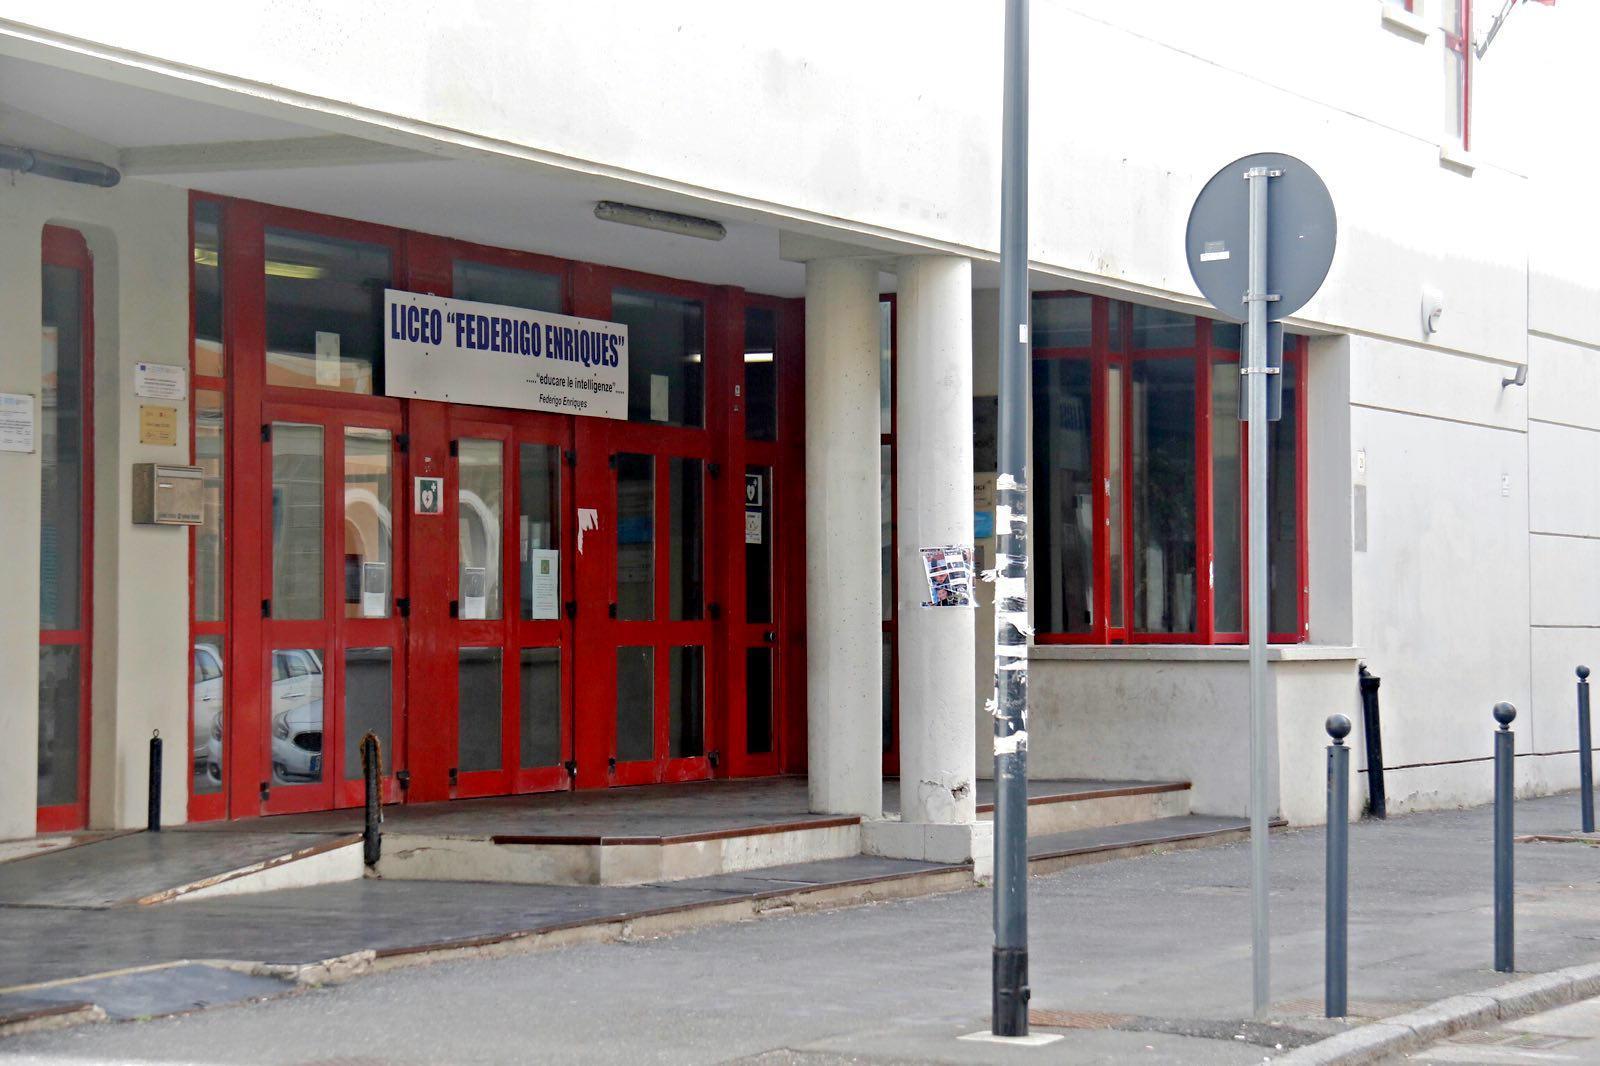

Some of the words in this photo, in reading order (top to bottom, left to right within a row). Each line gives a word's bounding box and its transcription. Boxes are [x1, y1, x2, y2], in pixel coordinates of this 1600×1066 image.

[391, 303, 442, 346] LICEO
[447, 312, 541, 357] “FEDERIGO
[545, 324, 625, 368] ENRIQUES”
[567, 376, 573, 388] le
[539, 393, 561, 407] Federigo
[562, 396, 588, 409] Enriques
